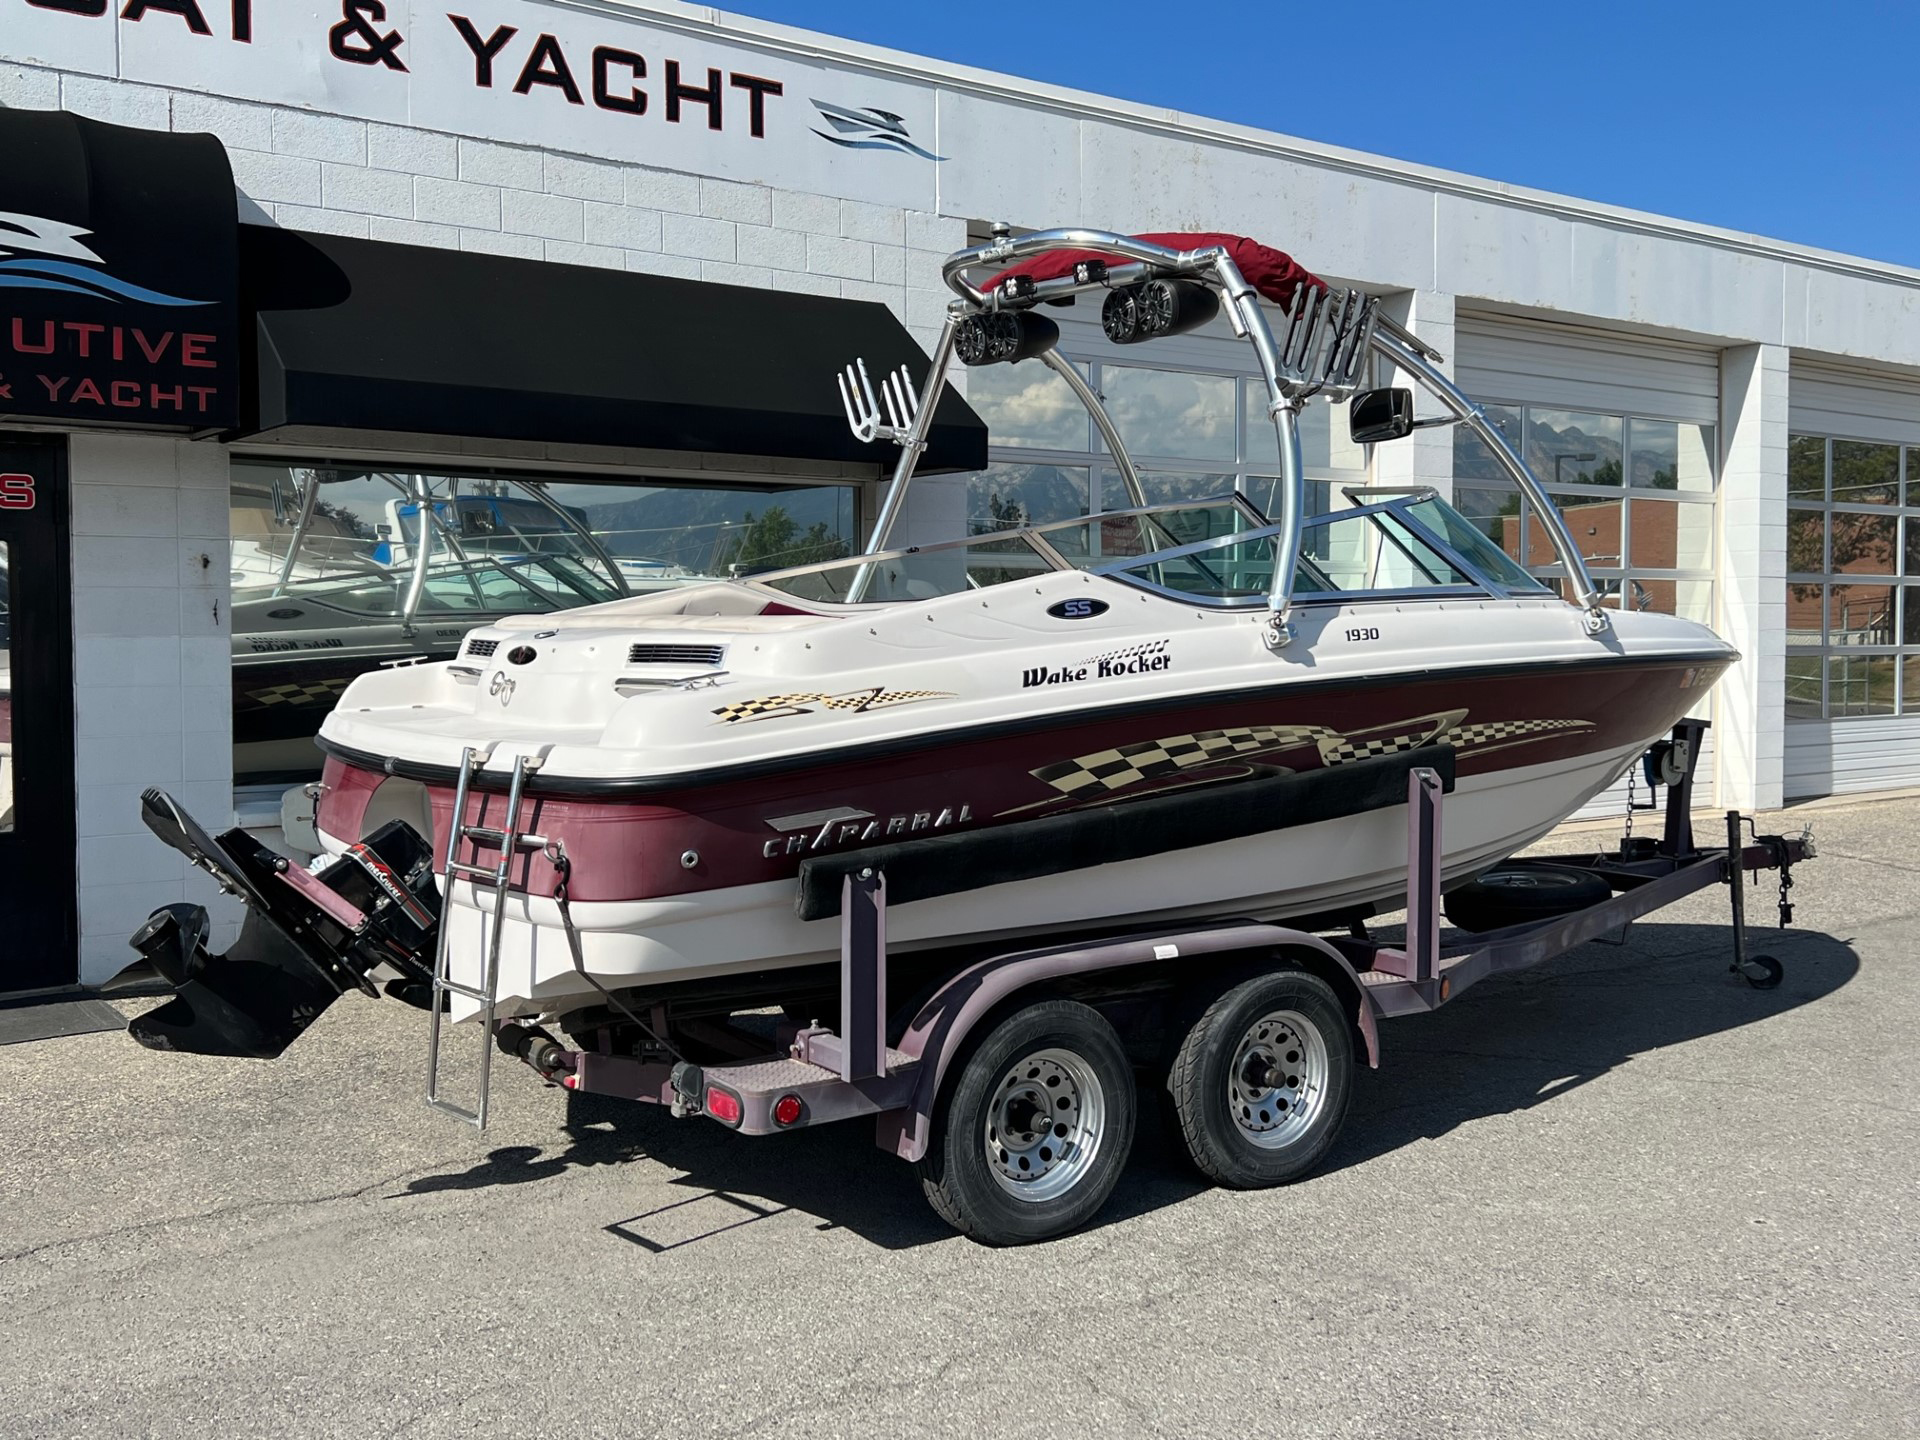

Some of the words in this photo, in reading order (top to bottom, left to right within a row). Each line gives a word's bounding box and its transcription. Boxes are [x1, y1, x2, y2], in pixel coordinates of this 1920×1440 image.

[329, 0, 410, 73] &
[446, 13, 784, 139] YACHT
[12, 318, 217, 368] UTIVE
[37, 374, 218, 412] YACHT
[1063, 600, 1093, 616] SS
[1345, 627, 1380, 642] 1930
[1022, 666, 1087, 688] Wake
[1097, 654, 1171, 678] Rocker
[763, 804, 974, 859] CHAPARRAL
